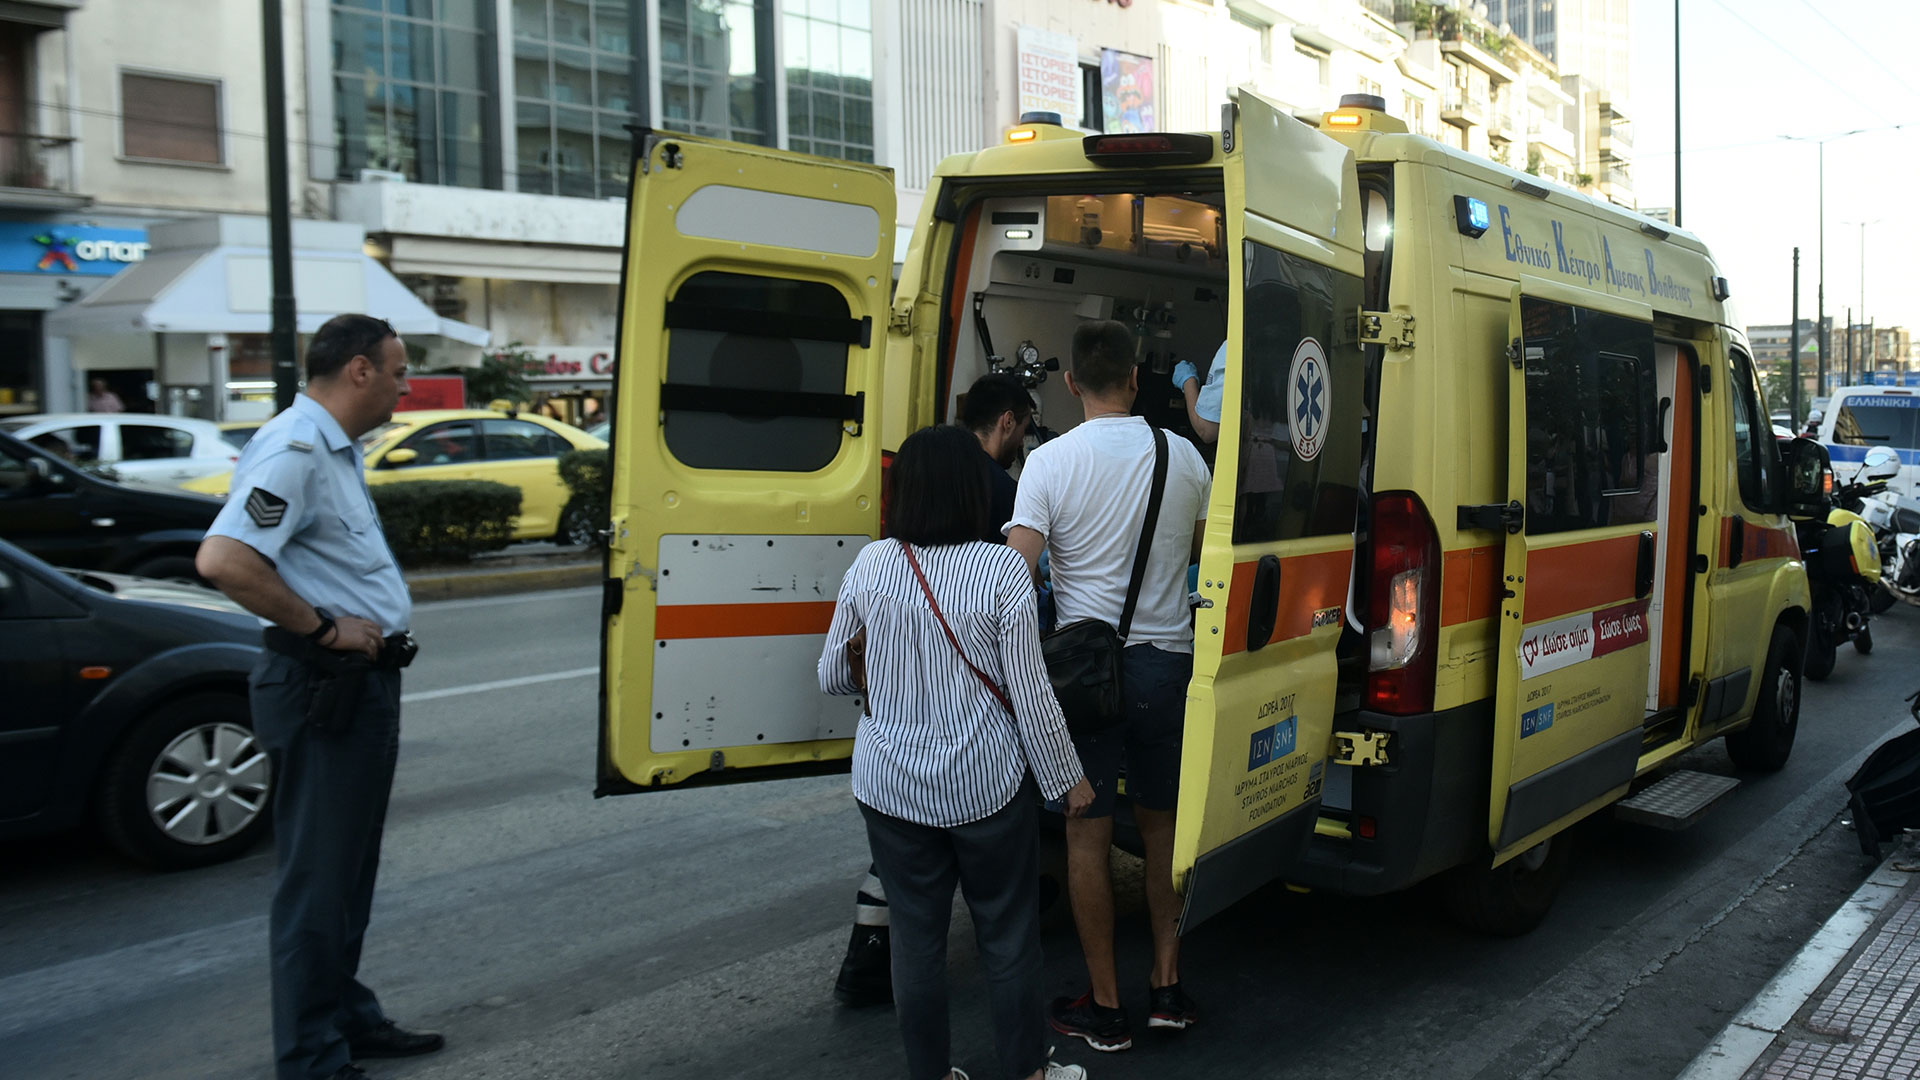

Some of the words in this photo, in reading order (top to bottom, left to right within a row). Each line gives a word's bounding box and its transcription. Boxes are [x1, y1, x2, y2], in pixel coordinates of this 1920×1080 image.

[1021, 52, 1075, 75] ΙΣΤΟΡΙΕΣ
[1022, 66, 1076, 88] ΙΣΤΟΡΙΕΣ
[1022, 80, 1076, 102] ΙΣΤΟΡΙΕΣ
[1498, 204, 1551, 270] Εθνικό
[1551, 219, 1600, 285] Κέντρο
[1603, 234, 1645, 298] Αμεσης
[1644, 248, 1693, 309] Βοήθειας
[1847, 396, 1911, 408] ΕΛΛΗΝΙΚΗ
[1542, 630, 1568, 657] Δώσε
[1569, 623, 1590, 652] αίμα
[1600, 616, 1621, 641] Σώσε
[1622, 610, 1642, 638] ζωές
[1257, 700, 1279, 720] ΔΩΡΕΑ
[1280, 693, 1296, 711] 2017
[1523, 716, 1536, 731] ΙΣΝ
[1538, 709, 1552, 726] SNF
[1252, 737, 1271, 760] ΙΣΝ
[1275, 726, 1293, 750] SNF
[1234, 776, 1257, 797] ΙΔΡΥΜΑ
[1258, 763, 1284, 785] ΣΤΑΥΡΟΣ
[1284, 752, 1308, 770] ΝΙΑΡΧΟΣ
[1242, 787, 1268, 809] STAVROS
[1268, 772, 1298, 796] NIARCHOS
[1249, 793, 1287, 822] FOUNDATION
